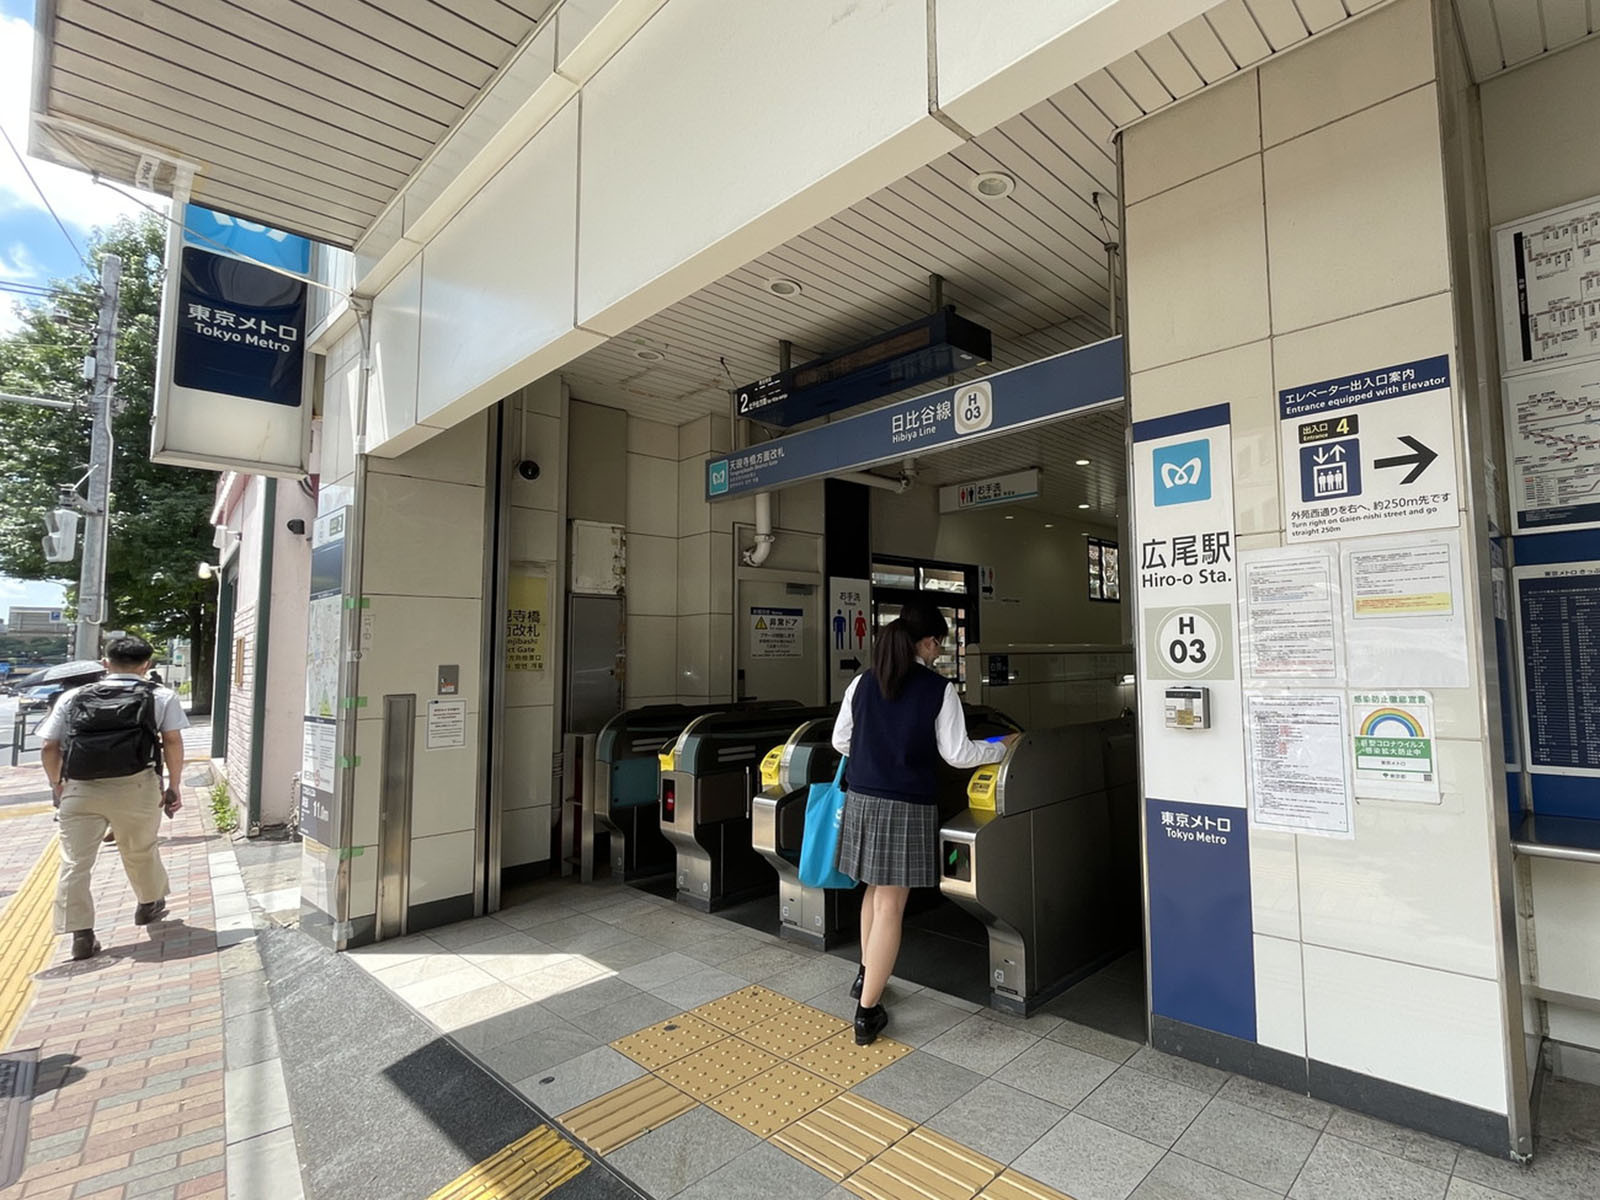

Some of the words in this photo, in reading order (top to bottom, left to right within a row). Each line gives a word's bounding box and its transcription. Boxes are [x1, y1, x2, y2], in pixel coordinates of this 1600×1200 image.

[187, 303, 297, 341] 東京メトロ
[194, 322, 241, 342] Tokyo
[245, 334, 290, 353] Metro
[1285, 368, 1415, 405] エレベーター出入口案内
[1286, 401, 1326, 415] Entrance
[1328, 391, 1374, 407] equipped
[1375, 385, 1399, 398] with
[1402, 376, 1446, 392] Elevator
[740, 393, 749, 413] 2
[968, 393, 977, 407] H
[892, 400, 952, 434] 日比谷線
[965, 406, 981, 421] 03
[892, 430, 917, 443] Hibiya
[919, 426, 937, 437] Line
[1303, 423, 1329, 435] 出入口
[1336, 418, 1350, 434] 4
[1309, 519, 1327, 527] right
[1339, 512, 1382, 523] Gaien-nishi
[1383, 510, 1407, 518] street
[1292, 528, 1319, 537] straight
[1321, 526, 1341, 534] 250m
[1141, 531, 1232, 571] 広尾駅
[1142, 570, 1193, 588] Hiro-o
[1199, 567, 1232, 584] Sta.
[1178, 616, 1195, 635] H
[1169, 638, 1207, 664] 03
[1160, 810, 1231, 833] 東京メトロ
[1166, 827, 1194, 842] Tokyo
[1196, 830, 1227, 845] Metro
